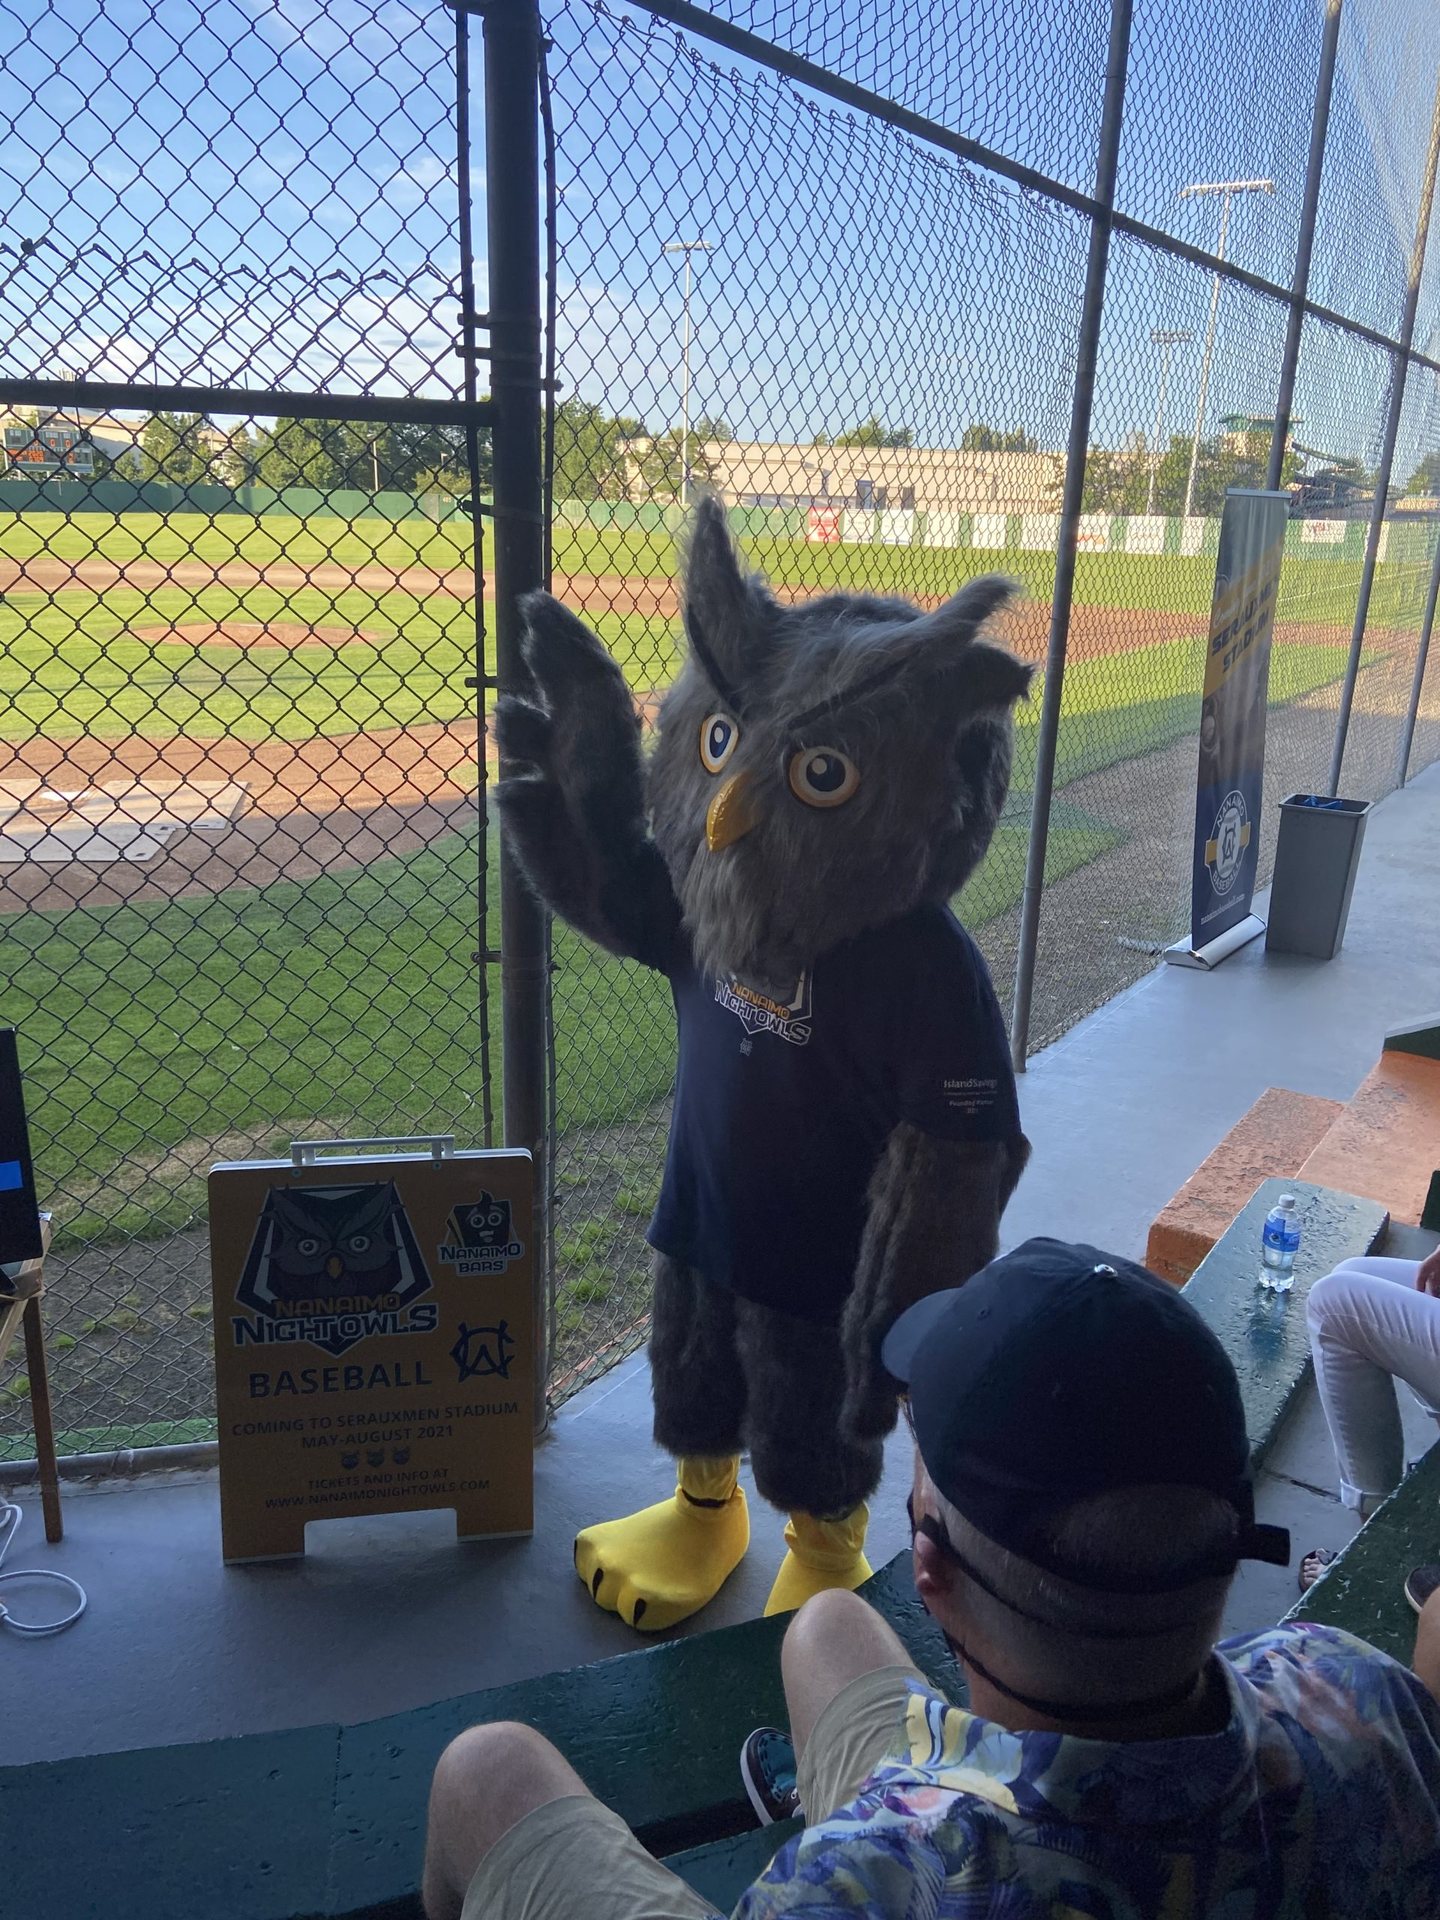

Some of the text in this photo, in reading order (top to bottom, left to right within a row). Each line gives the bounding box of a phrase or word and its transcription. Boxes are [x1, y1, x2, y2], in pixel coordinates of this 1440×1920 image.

[731, 981, 791, 1021] NANAIMO
[440, 1243, 521, 1261] NANAIMO
[459, 1260, 503, 1274] BARS
[273, 1293, 400, 1317] NANAIMO
[250, 1361, 433, 1398] BASEBALL
[232, 1402, 518, 1436] COMING TO SERAUXMEN STADIUM
[302, 1425, 453, 1448] MAY-AUGUST 2021
[309, 1469, 448, 1490] TICKETS AND INFO AT
[266, 1480, 490, 1508] WWW.NANAIMONIGHTOWLS.COM
